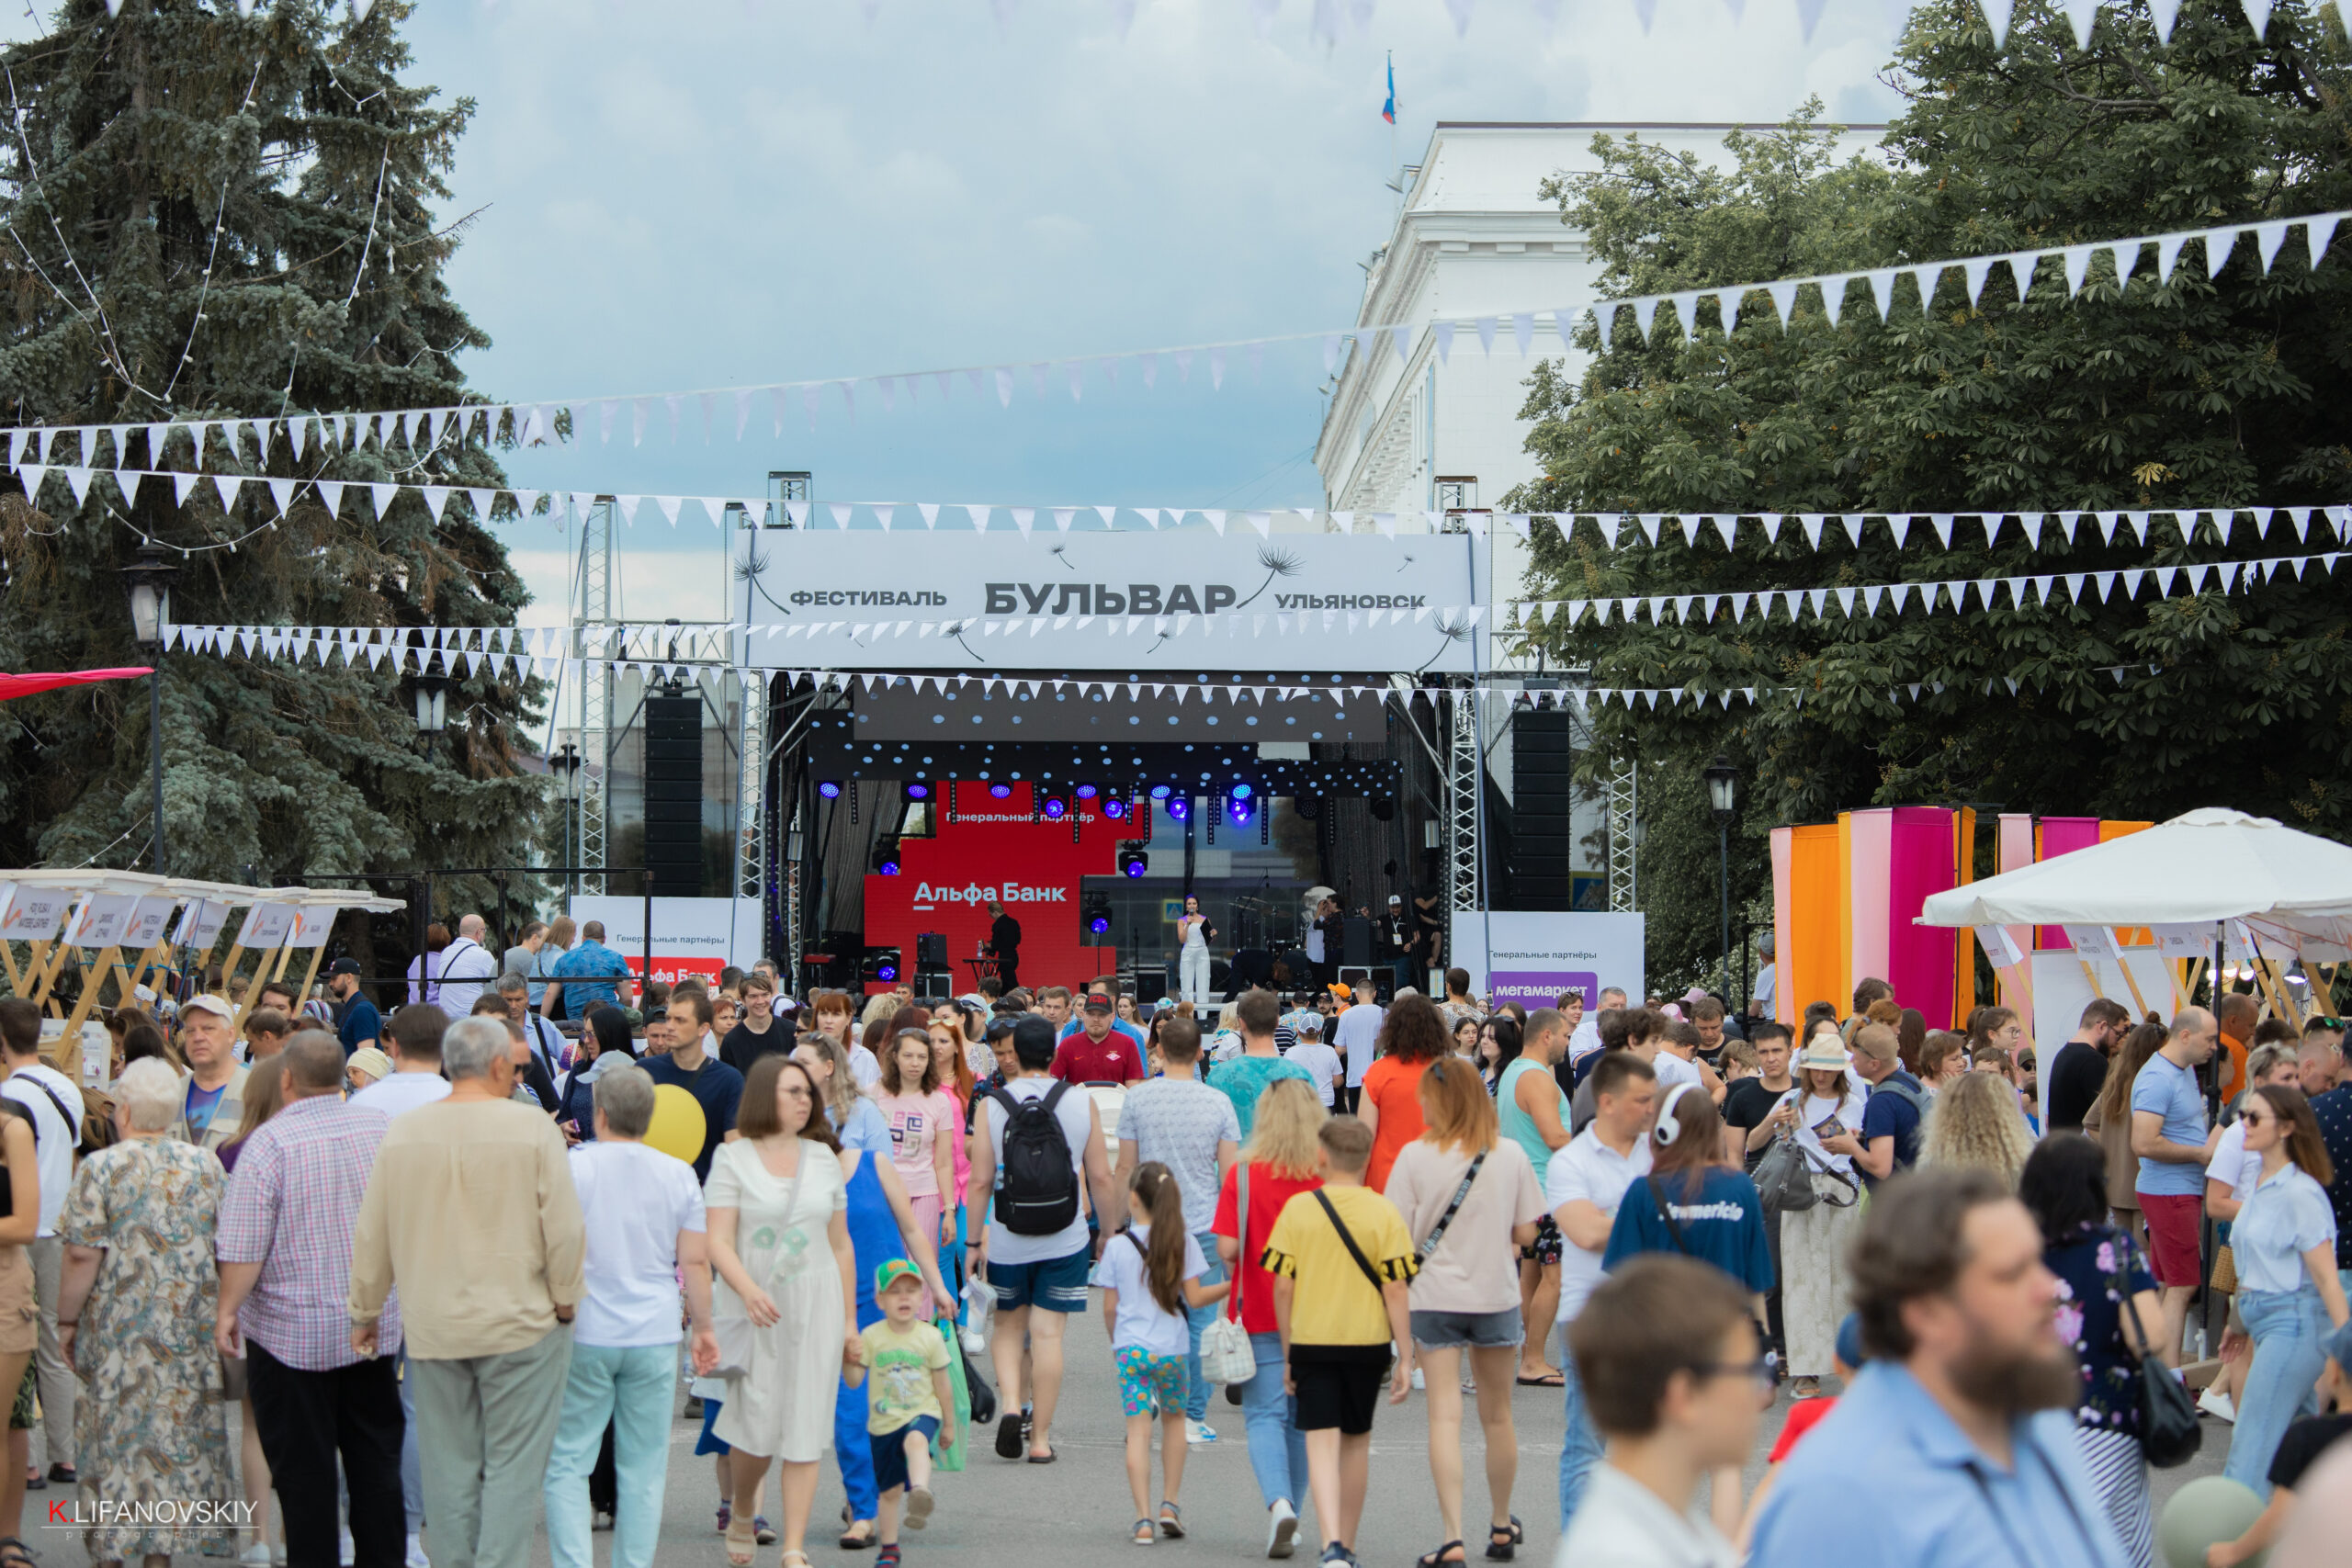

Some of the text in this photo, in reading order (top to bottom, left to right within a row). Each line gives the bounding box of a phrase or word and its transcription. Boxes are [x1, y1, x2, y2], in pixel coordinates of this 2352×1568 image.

[790, 582, 1427, 615] ФЕСТИВАЛЬ БУЛЬВАР УЛЬЯНОВСК
[913, 881, 1067, 908] Альфа Банк
[616, 934, 725, 945] Генерльные партнёры
[1488, 950, 1598, 961] енеральные партнёры
